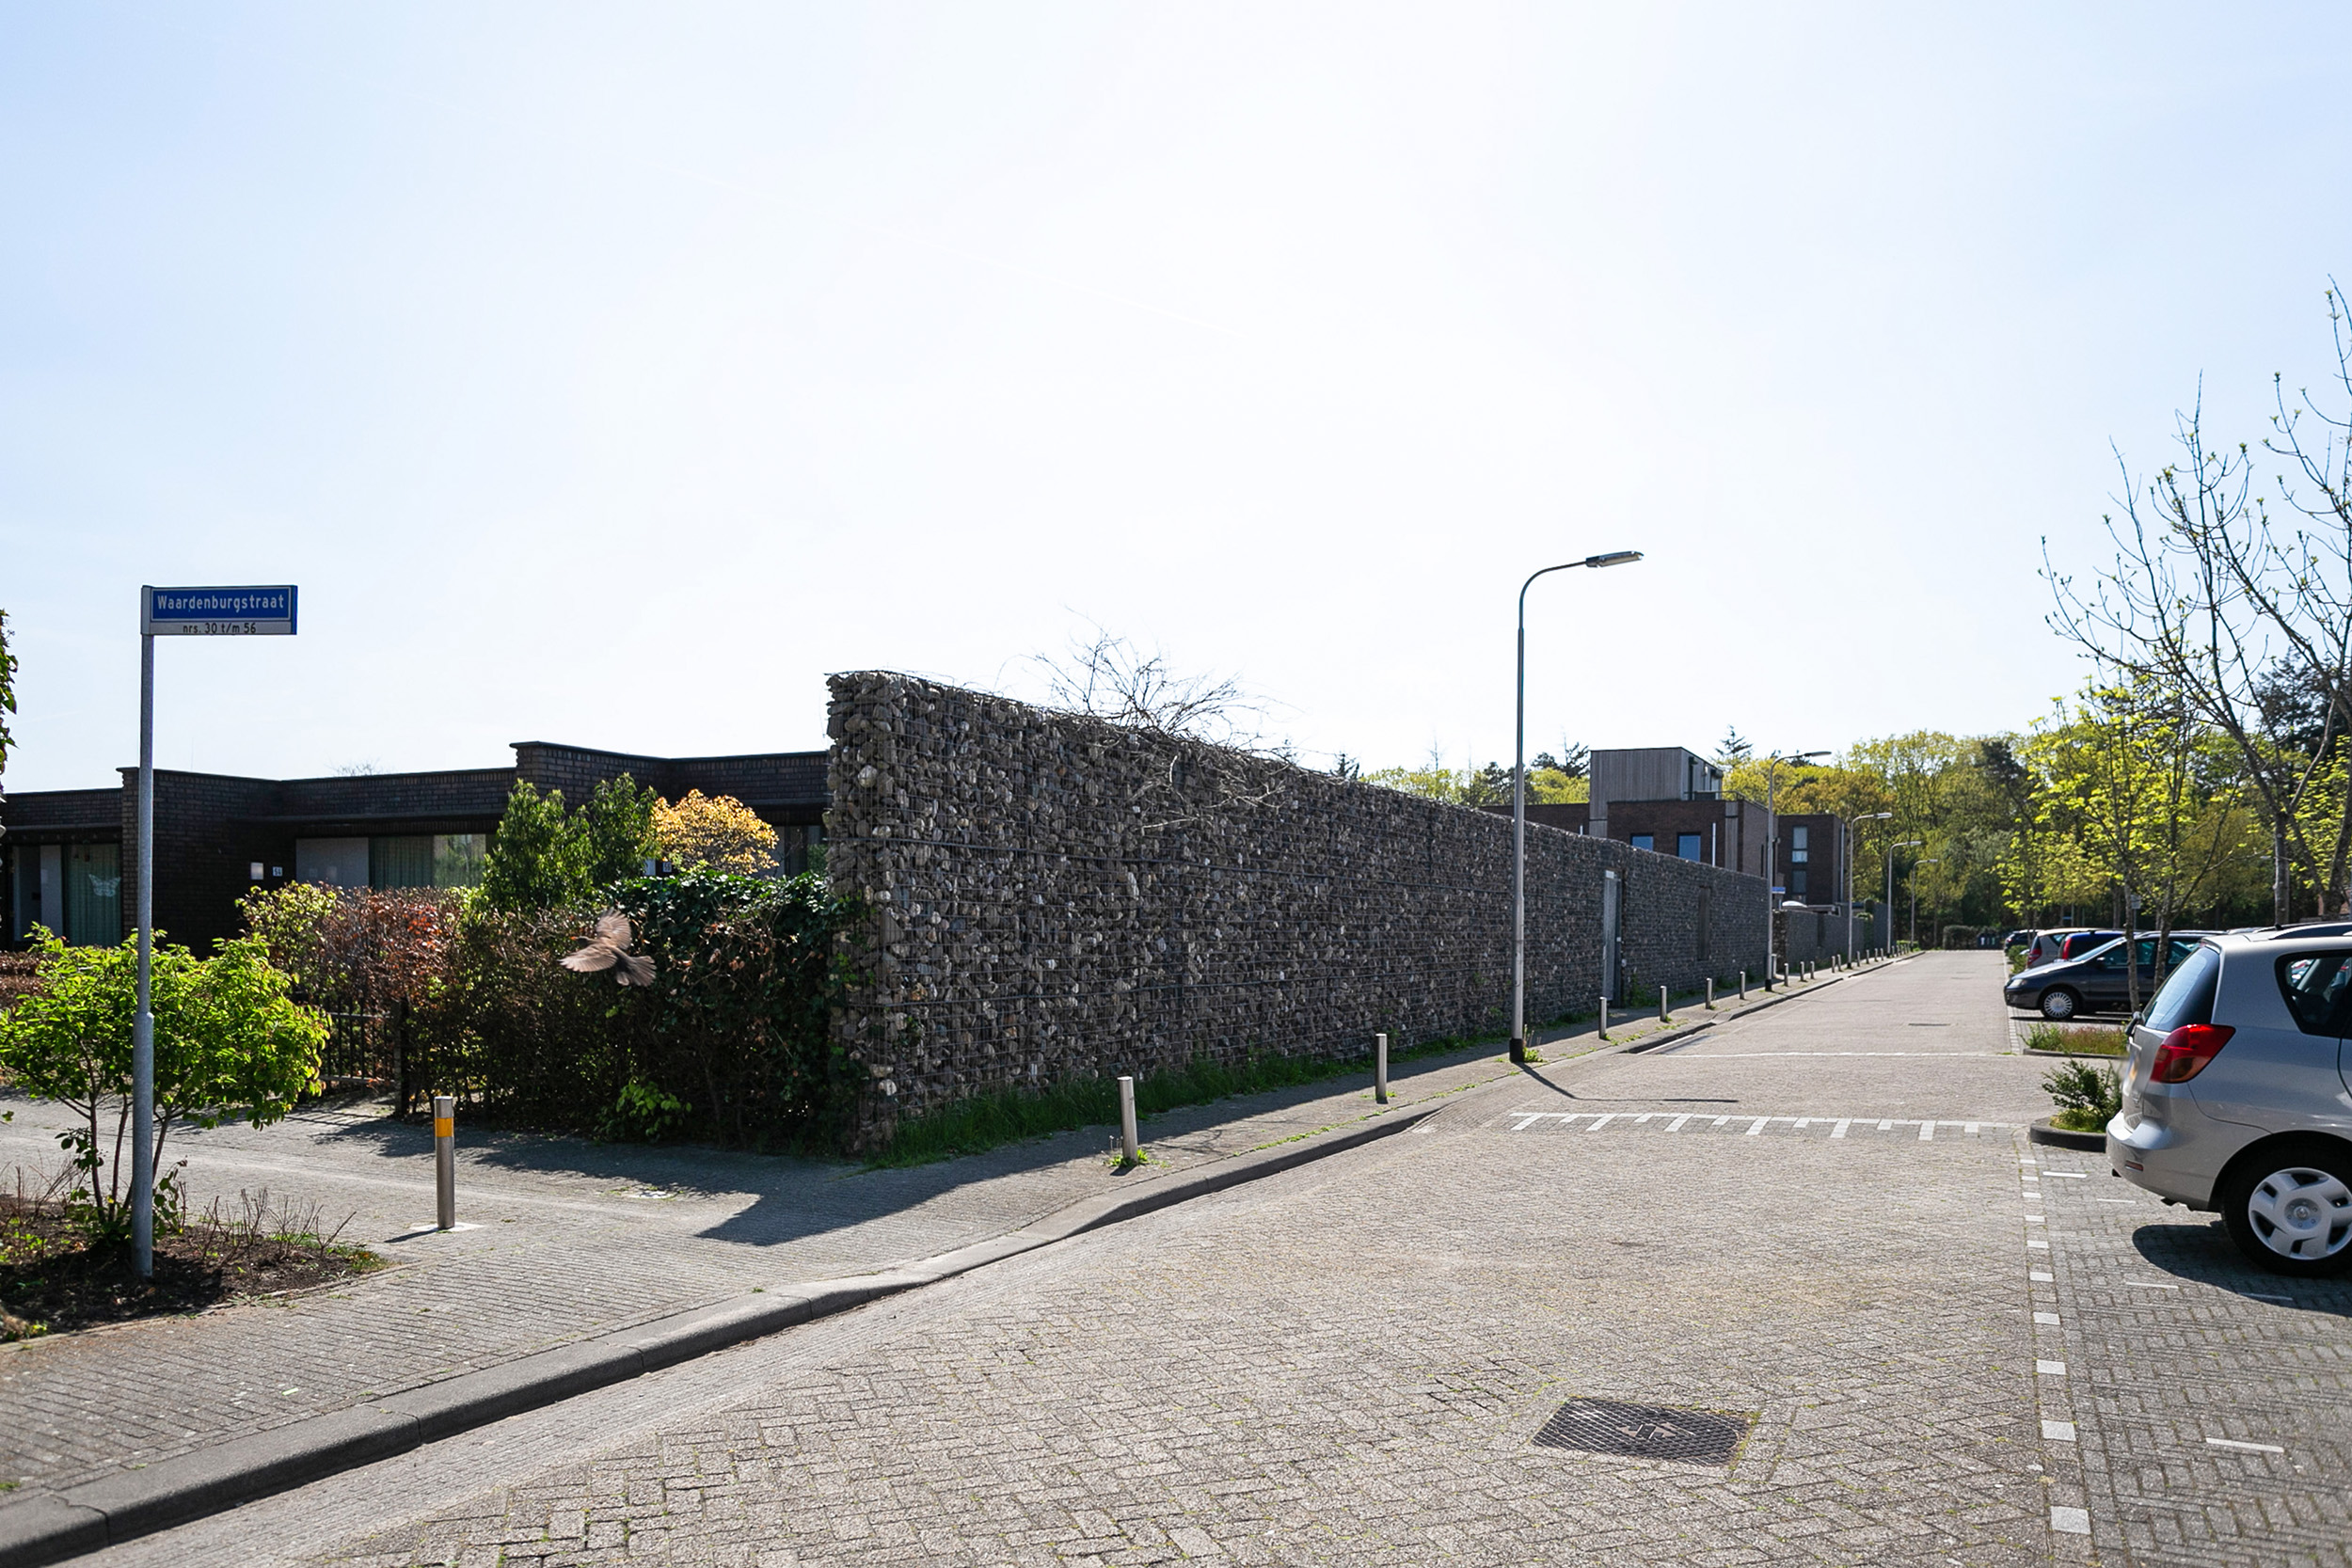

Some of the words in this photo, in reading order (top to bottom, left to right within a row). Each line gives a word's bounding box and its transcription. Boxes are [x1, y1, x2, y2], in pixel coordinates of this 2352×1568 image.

[157, 594, 284, 612] Waardenburgstraat
[183, 624, 201, 633] nrs.
[204, 623, 217, 633] 30
[221, 623, 240, 633] t/m
[244, 622, 257, 633] 56
